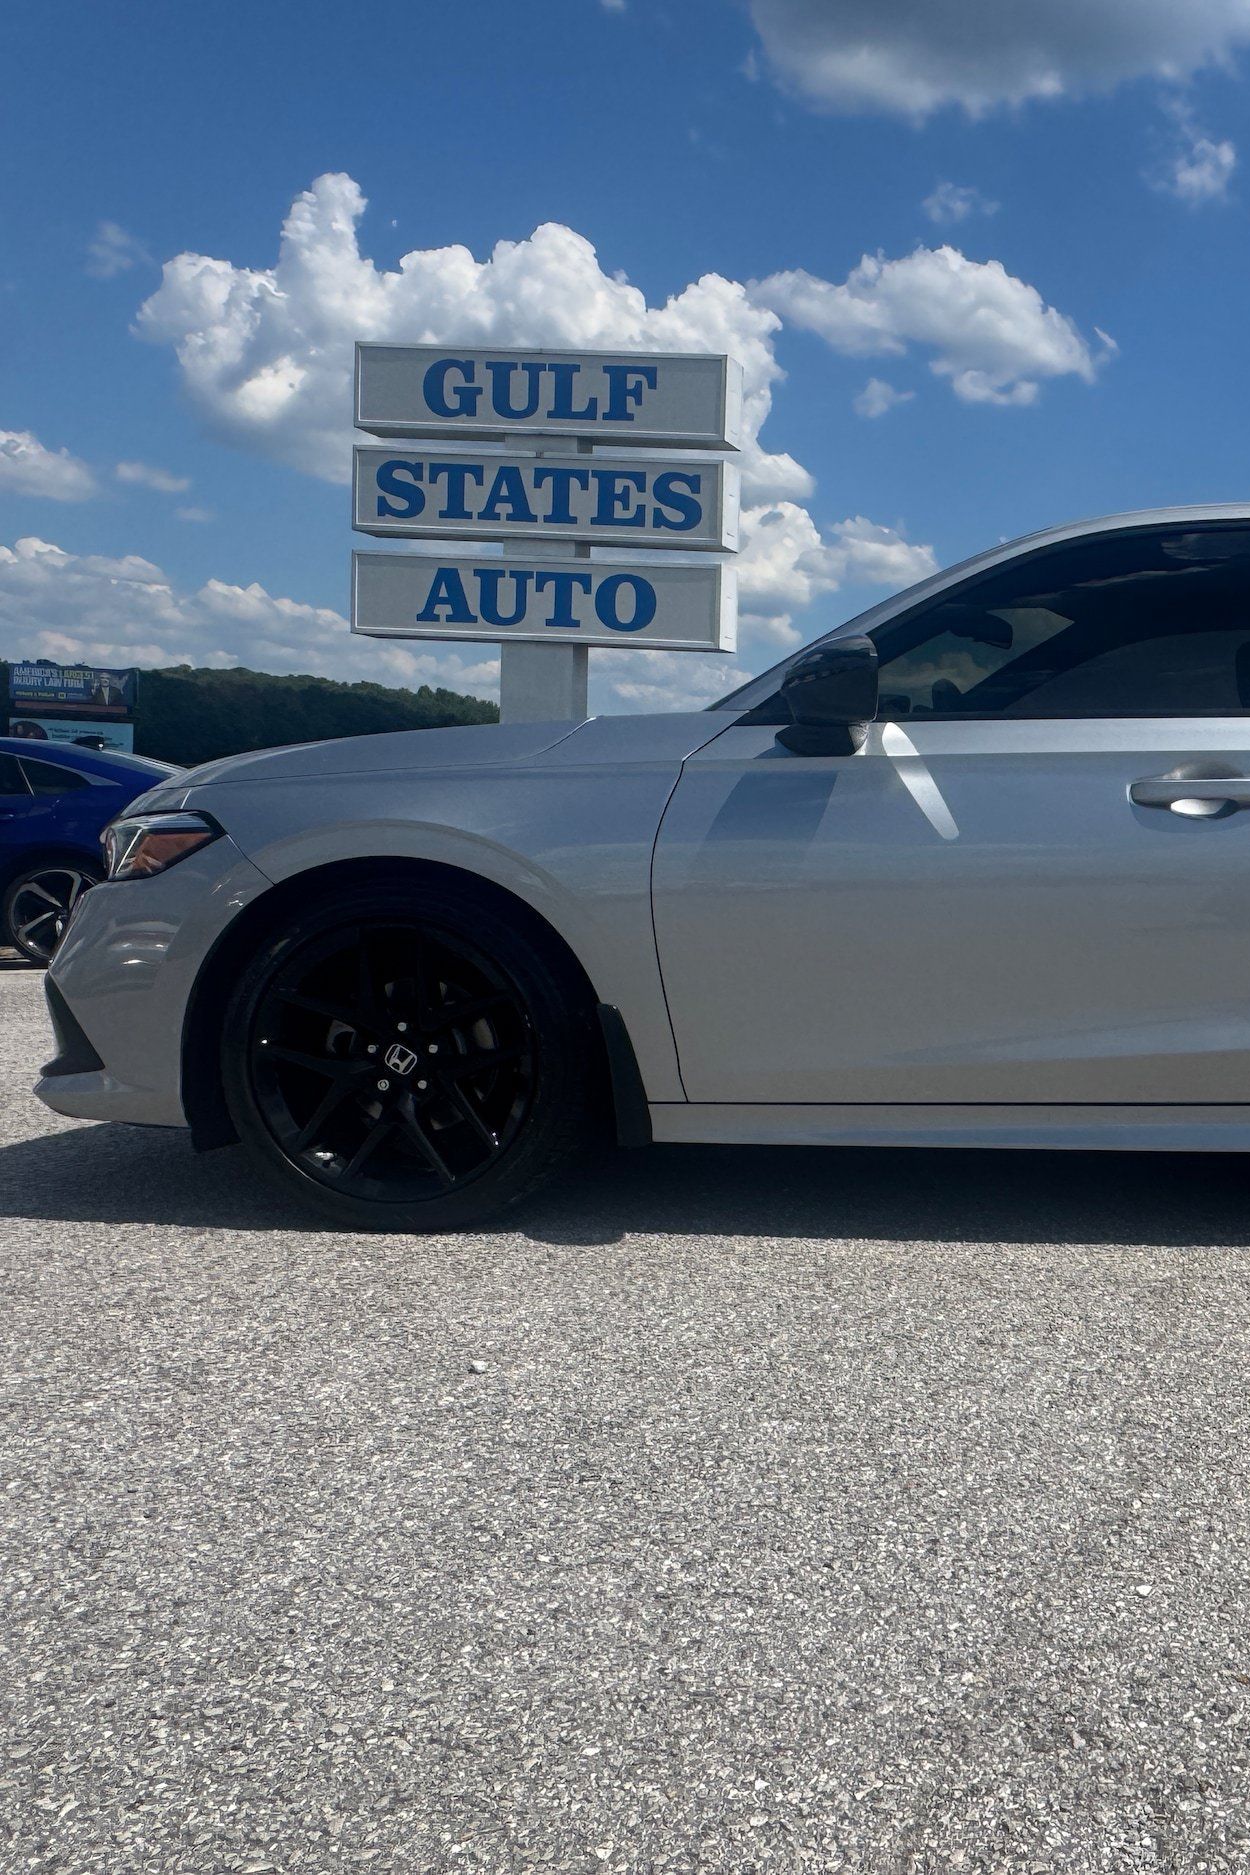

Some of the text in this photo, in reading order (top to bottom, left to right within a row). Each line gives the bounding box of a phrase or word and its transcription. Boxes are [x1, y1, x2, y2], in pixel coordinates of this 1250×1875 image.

[422, 358, 658, 421] GULF
[376, 460, 702, 531] STATES
[416, 567, 657, 632] AUTO
